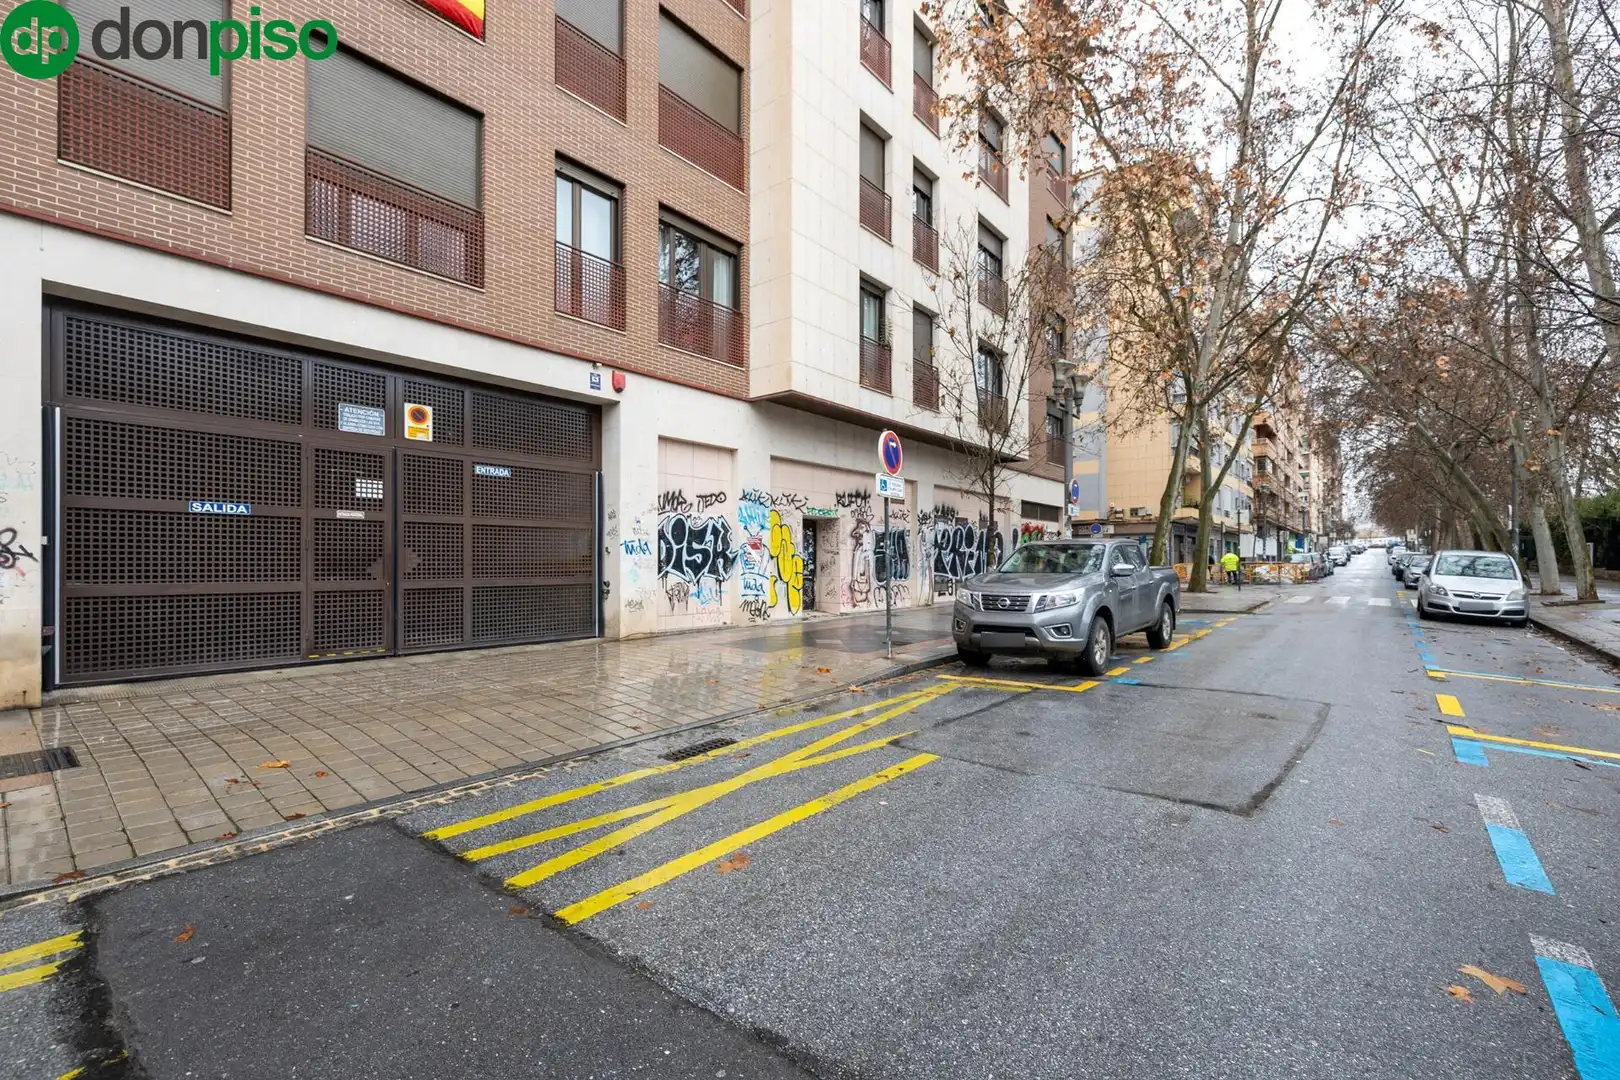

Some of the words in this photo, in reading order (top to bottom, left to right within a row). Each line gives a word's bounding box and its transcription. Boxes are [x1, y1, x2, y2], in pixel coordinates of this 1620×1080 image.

[344, 406, 379, 417] ATENCIÓN
[476, 465, 509, 476] ENTRADA
[191, 502, 248, 514] SALIDA
